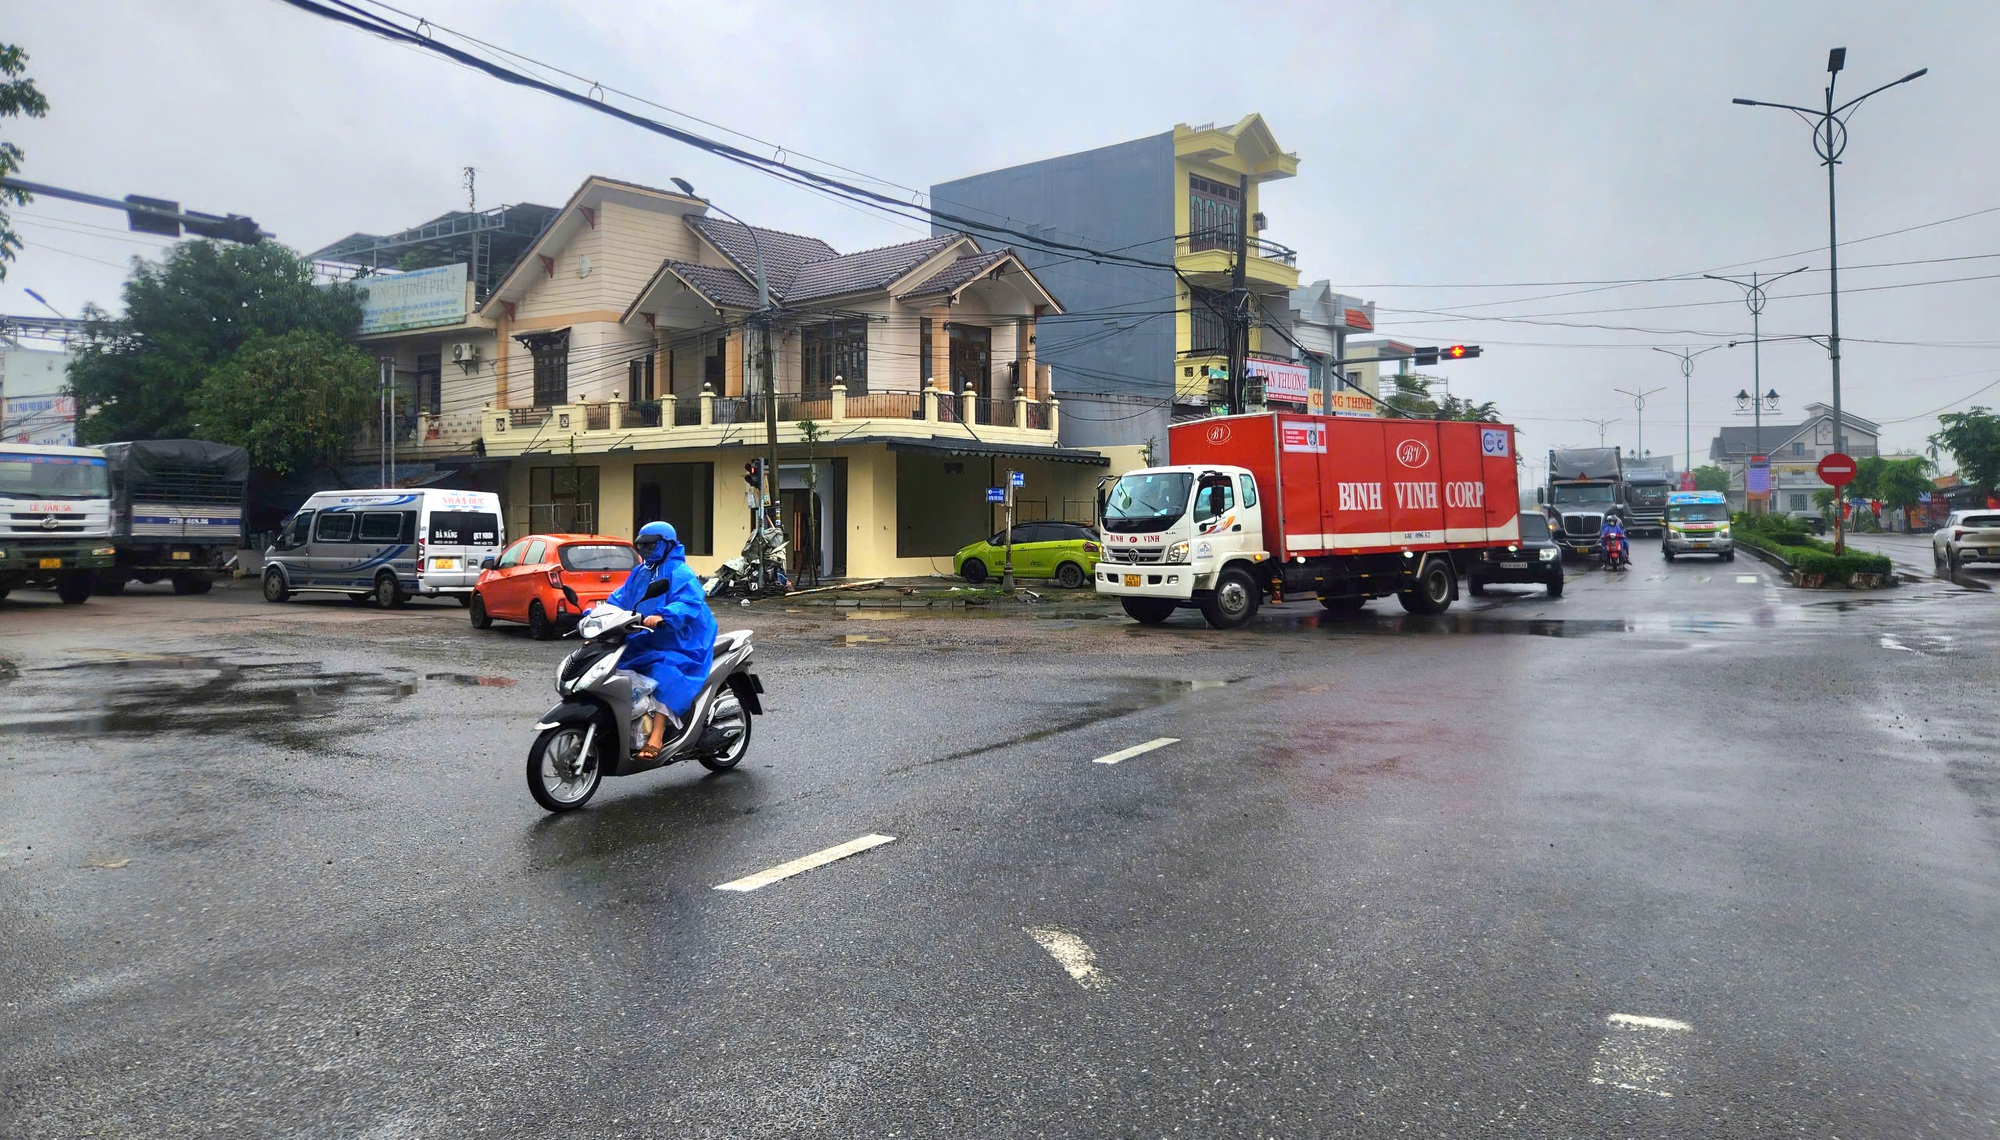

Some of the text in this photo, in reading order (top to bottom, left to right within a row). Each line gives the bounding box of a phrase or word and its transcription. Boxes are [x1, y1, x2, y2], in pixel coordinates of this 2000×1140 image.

[1338, 481, 1484, 510] BINH VINH CORP
[1110, 534, 1124, 543] BINH
